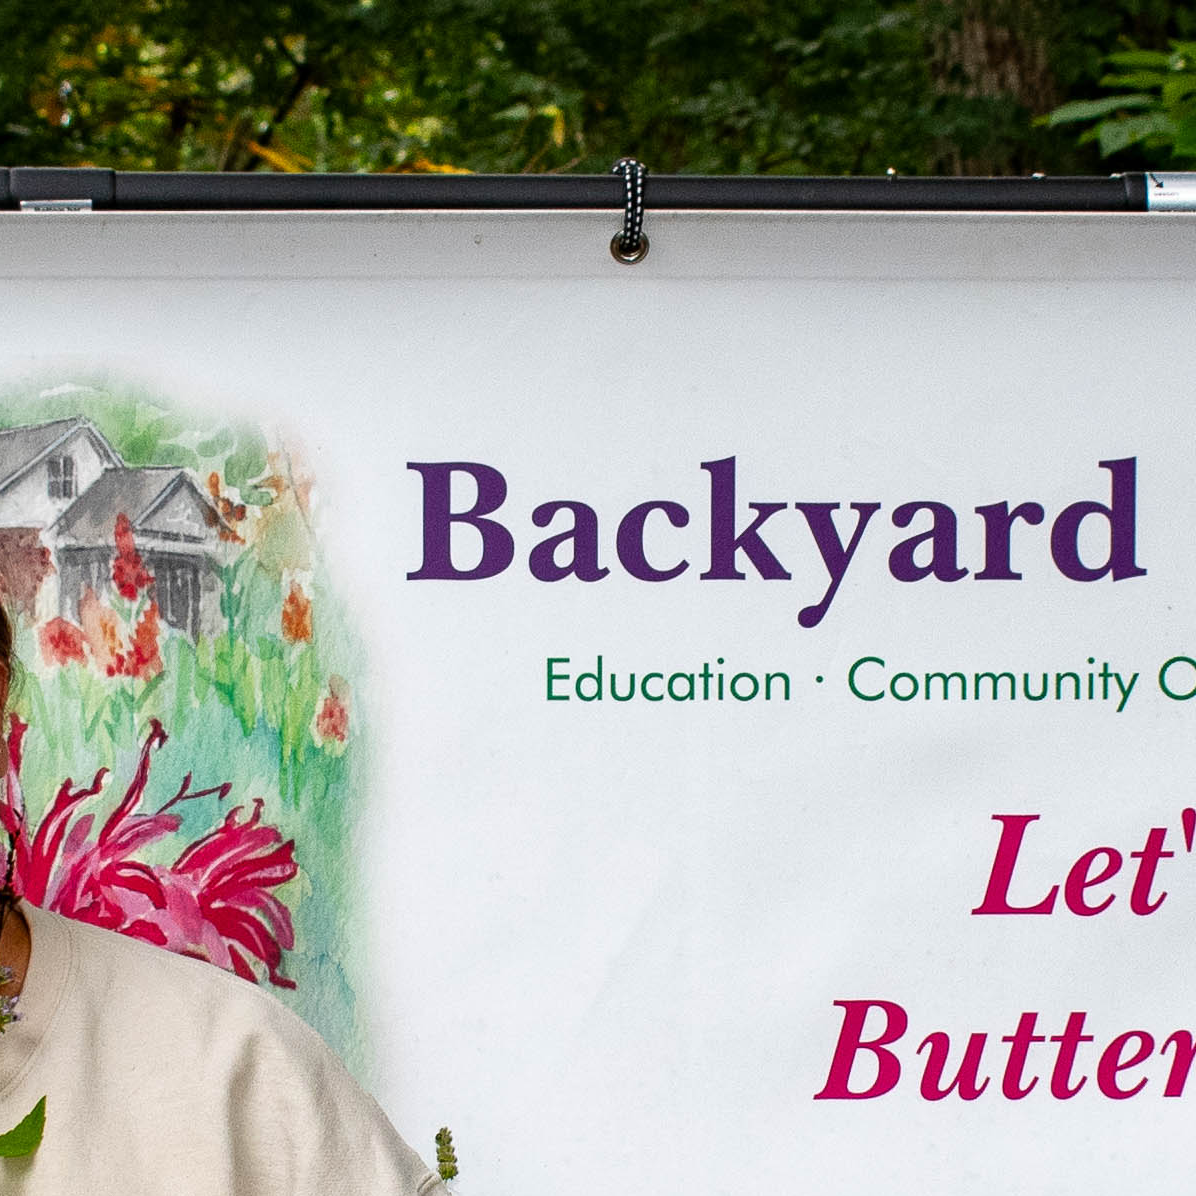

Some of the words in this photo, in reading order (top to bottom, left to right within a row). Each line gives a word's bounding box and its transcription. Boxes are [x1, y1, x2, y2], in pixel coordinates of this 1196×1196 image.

[406, 456, 1148, 628] Backyard
[546, 656, 791, 702] Education
[848, 656, 1140, 713] Community
[813, 999, 1196, 1101] Butter
